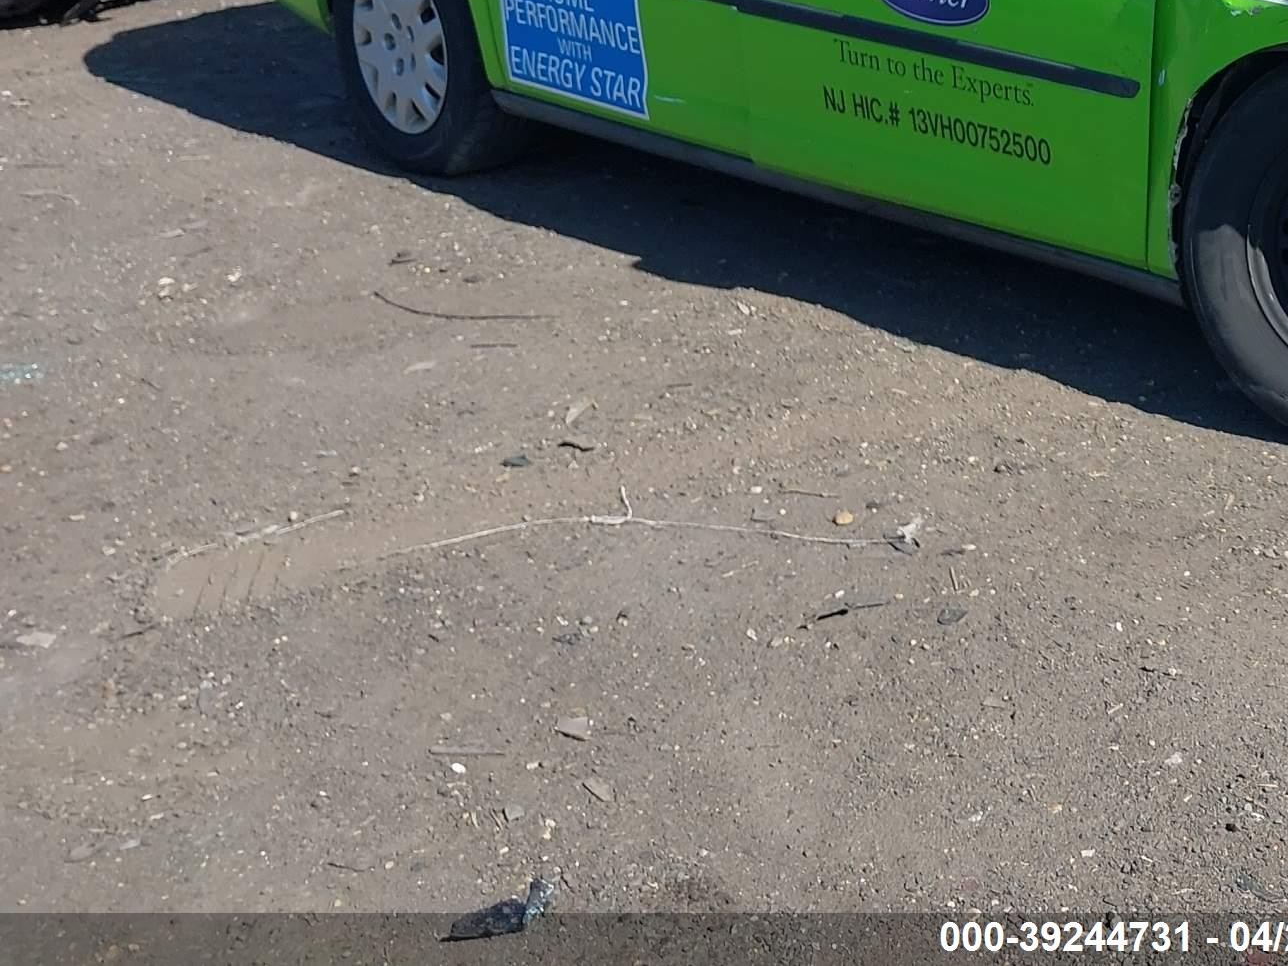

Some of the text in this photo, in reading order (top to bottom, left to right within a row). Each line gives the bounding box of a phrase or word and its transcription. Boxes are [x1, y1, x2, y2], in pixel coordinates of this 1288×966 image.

[510, 45, 642, 109] ENERGY STAR
[547, 37, 593, 63] WITH
[834, 38, 1035, 107] Turn to the Experts.
[823, 86, 1051, 166] NJ HIC.# 13VH00752500
